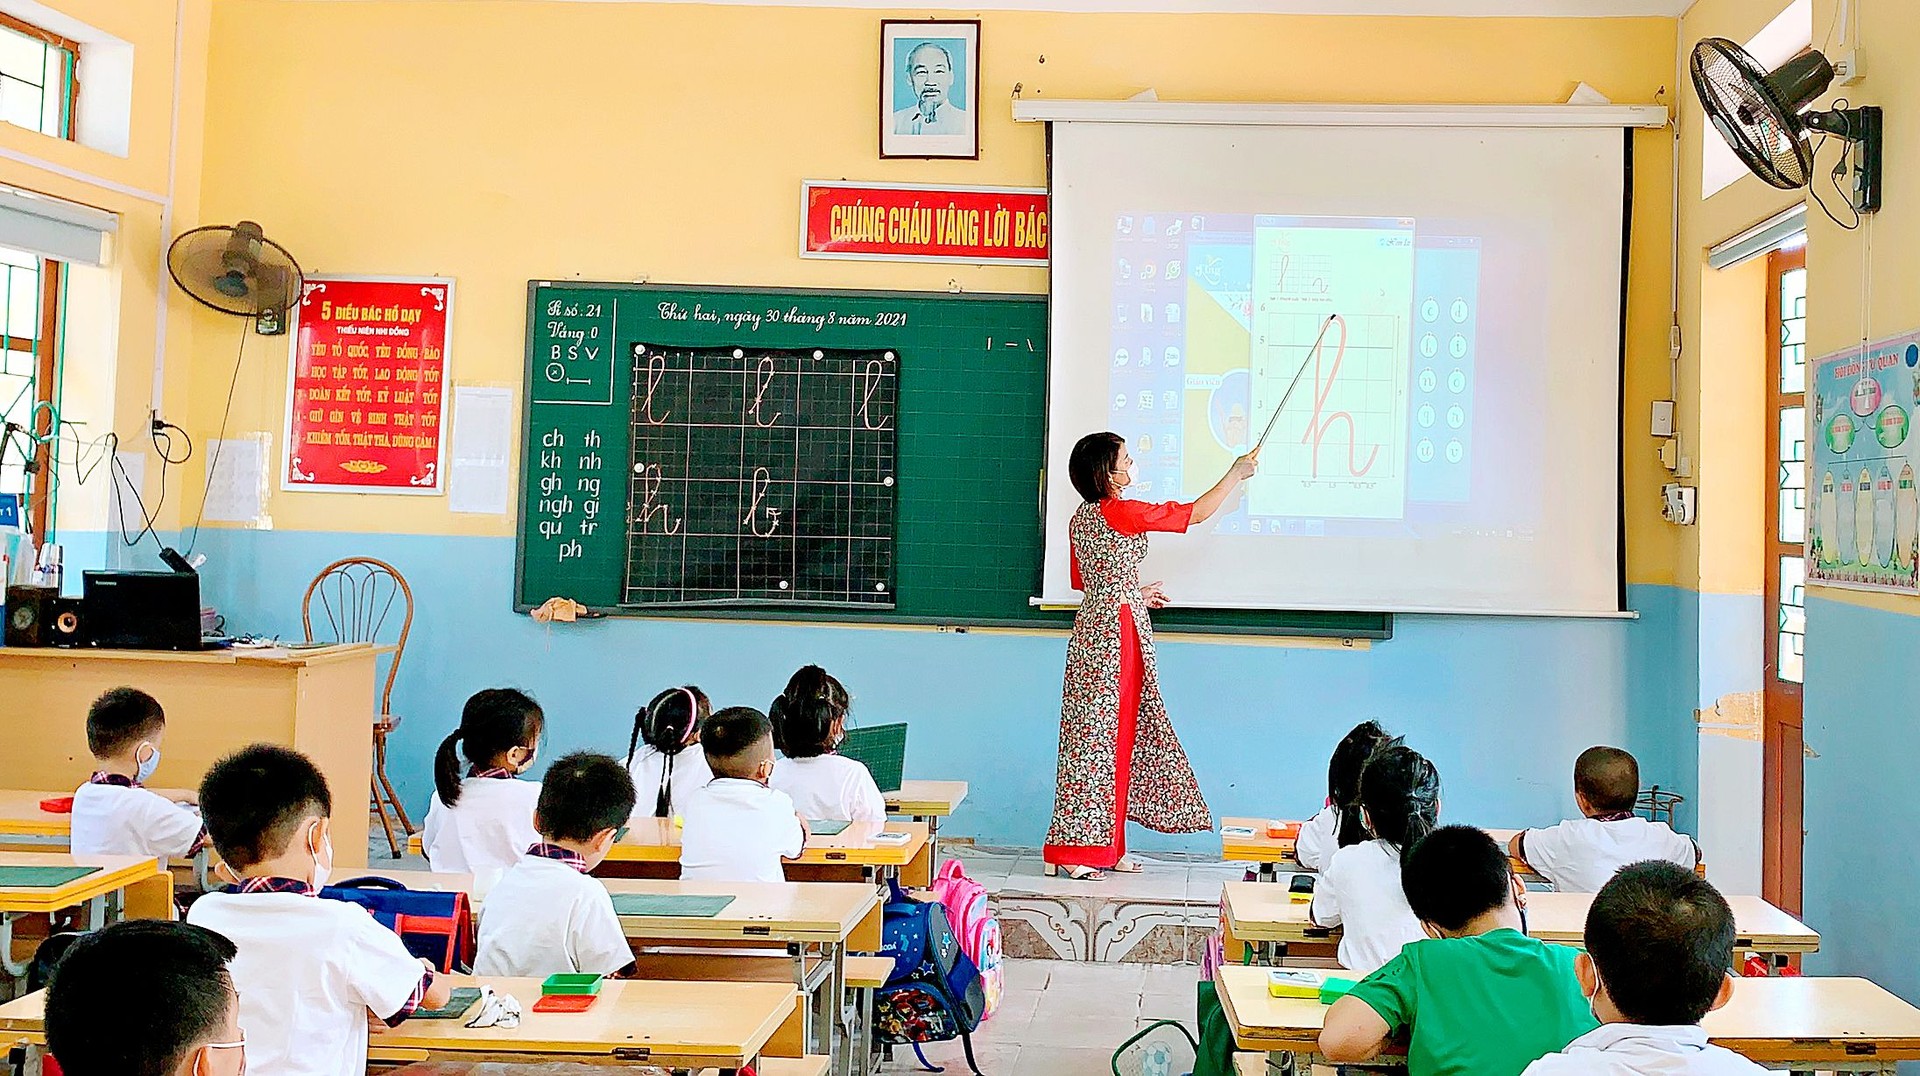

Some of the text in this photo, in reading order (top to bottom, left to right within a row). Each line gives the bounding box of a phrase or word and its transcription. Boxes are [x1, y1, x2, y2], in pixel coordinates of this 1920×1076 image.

[830, 199, 1047, 248] CHÚNG CHÁU VÂNG LỜI BÁC
[321, 301, 331, 320] 5
[361, 305, 382, 321] BÁC
[401, 309, 422, 325] DẠY
[586, 304, 601, 317] 21
[658, 302, 907, 331] Thứ hai, ngày 30 tháng 8 năm 2021
[551, 345, 599, 360] B S V
[311, 365, 327, 380] HỌC
[375, 368, 390, 380] LAO
[424, 365, 440, 382] TỐT
[423, 388, 438, 405] TỐT
[1301, 314, 1380, 478] h
[421, 410, 437, 427] TỐT
[542, 428, 600, 448] ch th
[541, 451, 601, 470] kh nh
[540, 472, 600, 497] gh ng
[539, 495, 600, 519] ngh gi
[539, 519, 598, 539] qu tr
[559, 539, 582, 562] ph
